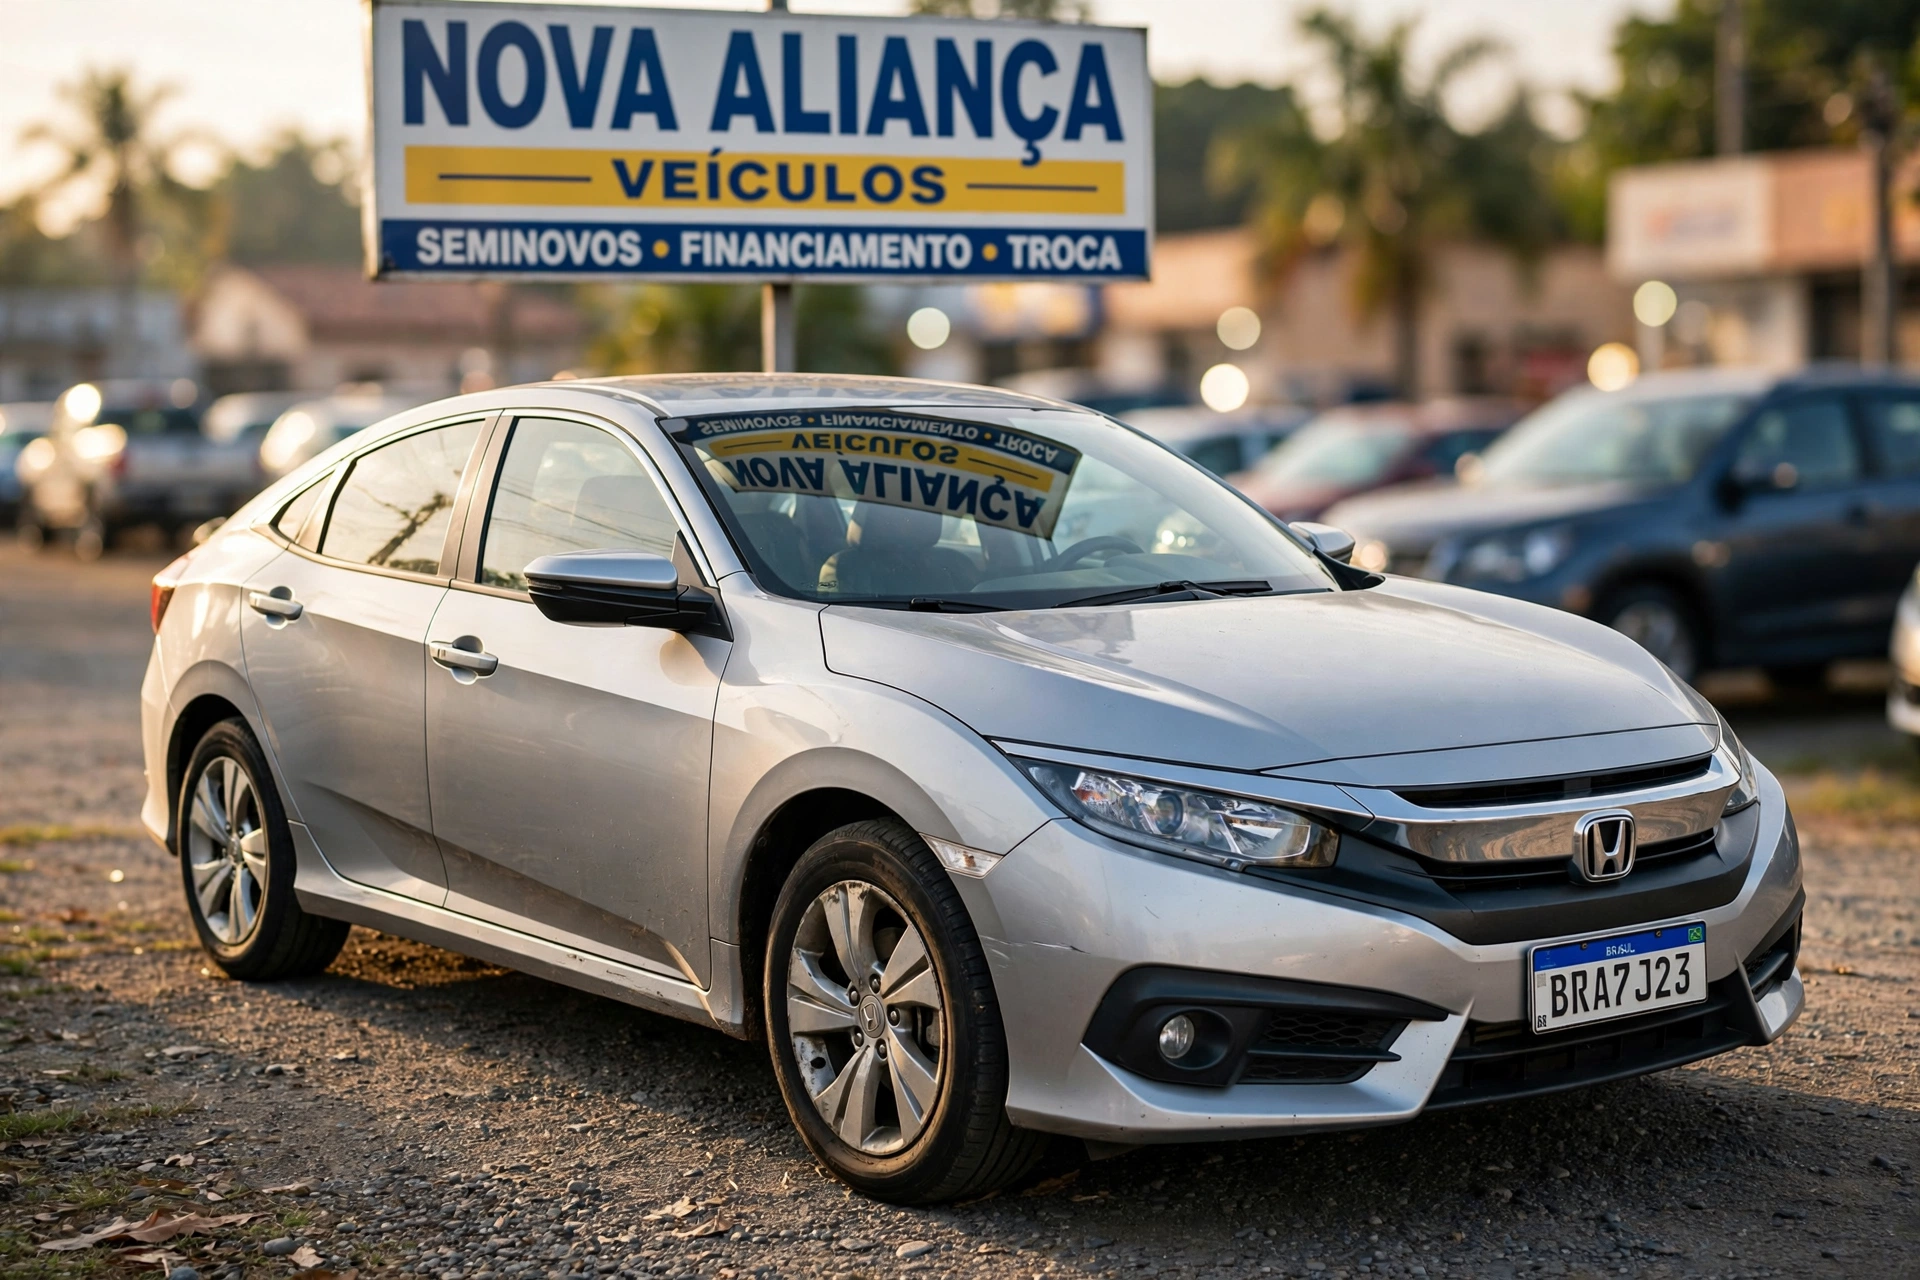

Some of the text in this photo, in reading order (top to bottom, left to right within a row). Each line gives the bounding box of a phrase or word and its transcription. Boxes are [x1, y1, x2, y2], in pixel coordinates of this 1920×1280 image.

[402, 19, 1124, 167] NOVA ALIANÇA
[612, 148, 947, 205] VEÍCULOS
[416, 228, 1121, 270] SEMINOVOS FINANCIAMENTO TROCA
[1551, 952, 1690, 1018] BRA7J23
